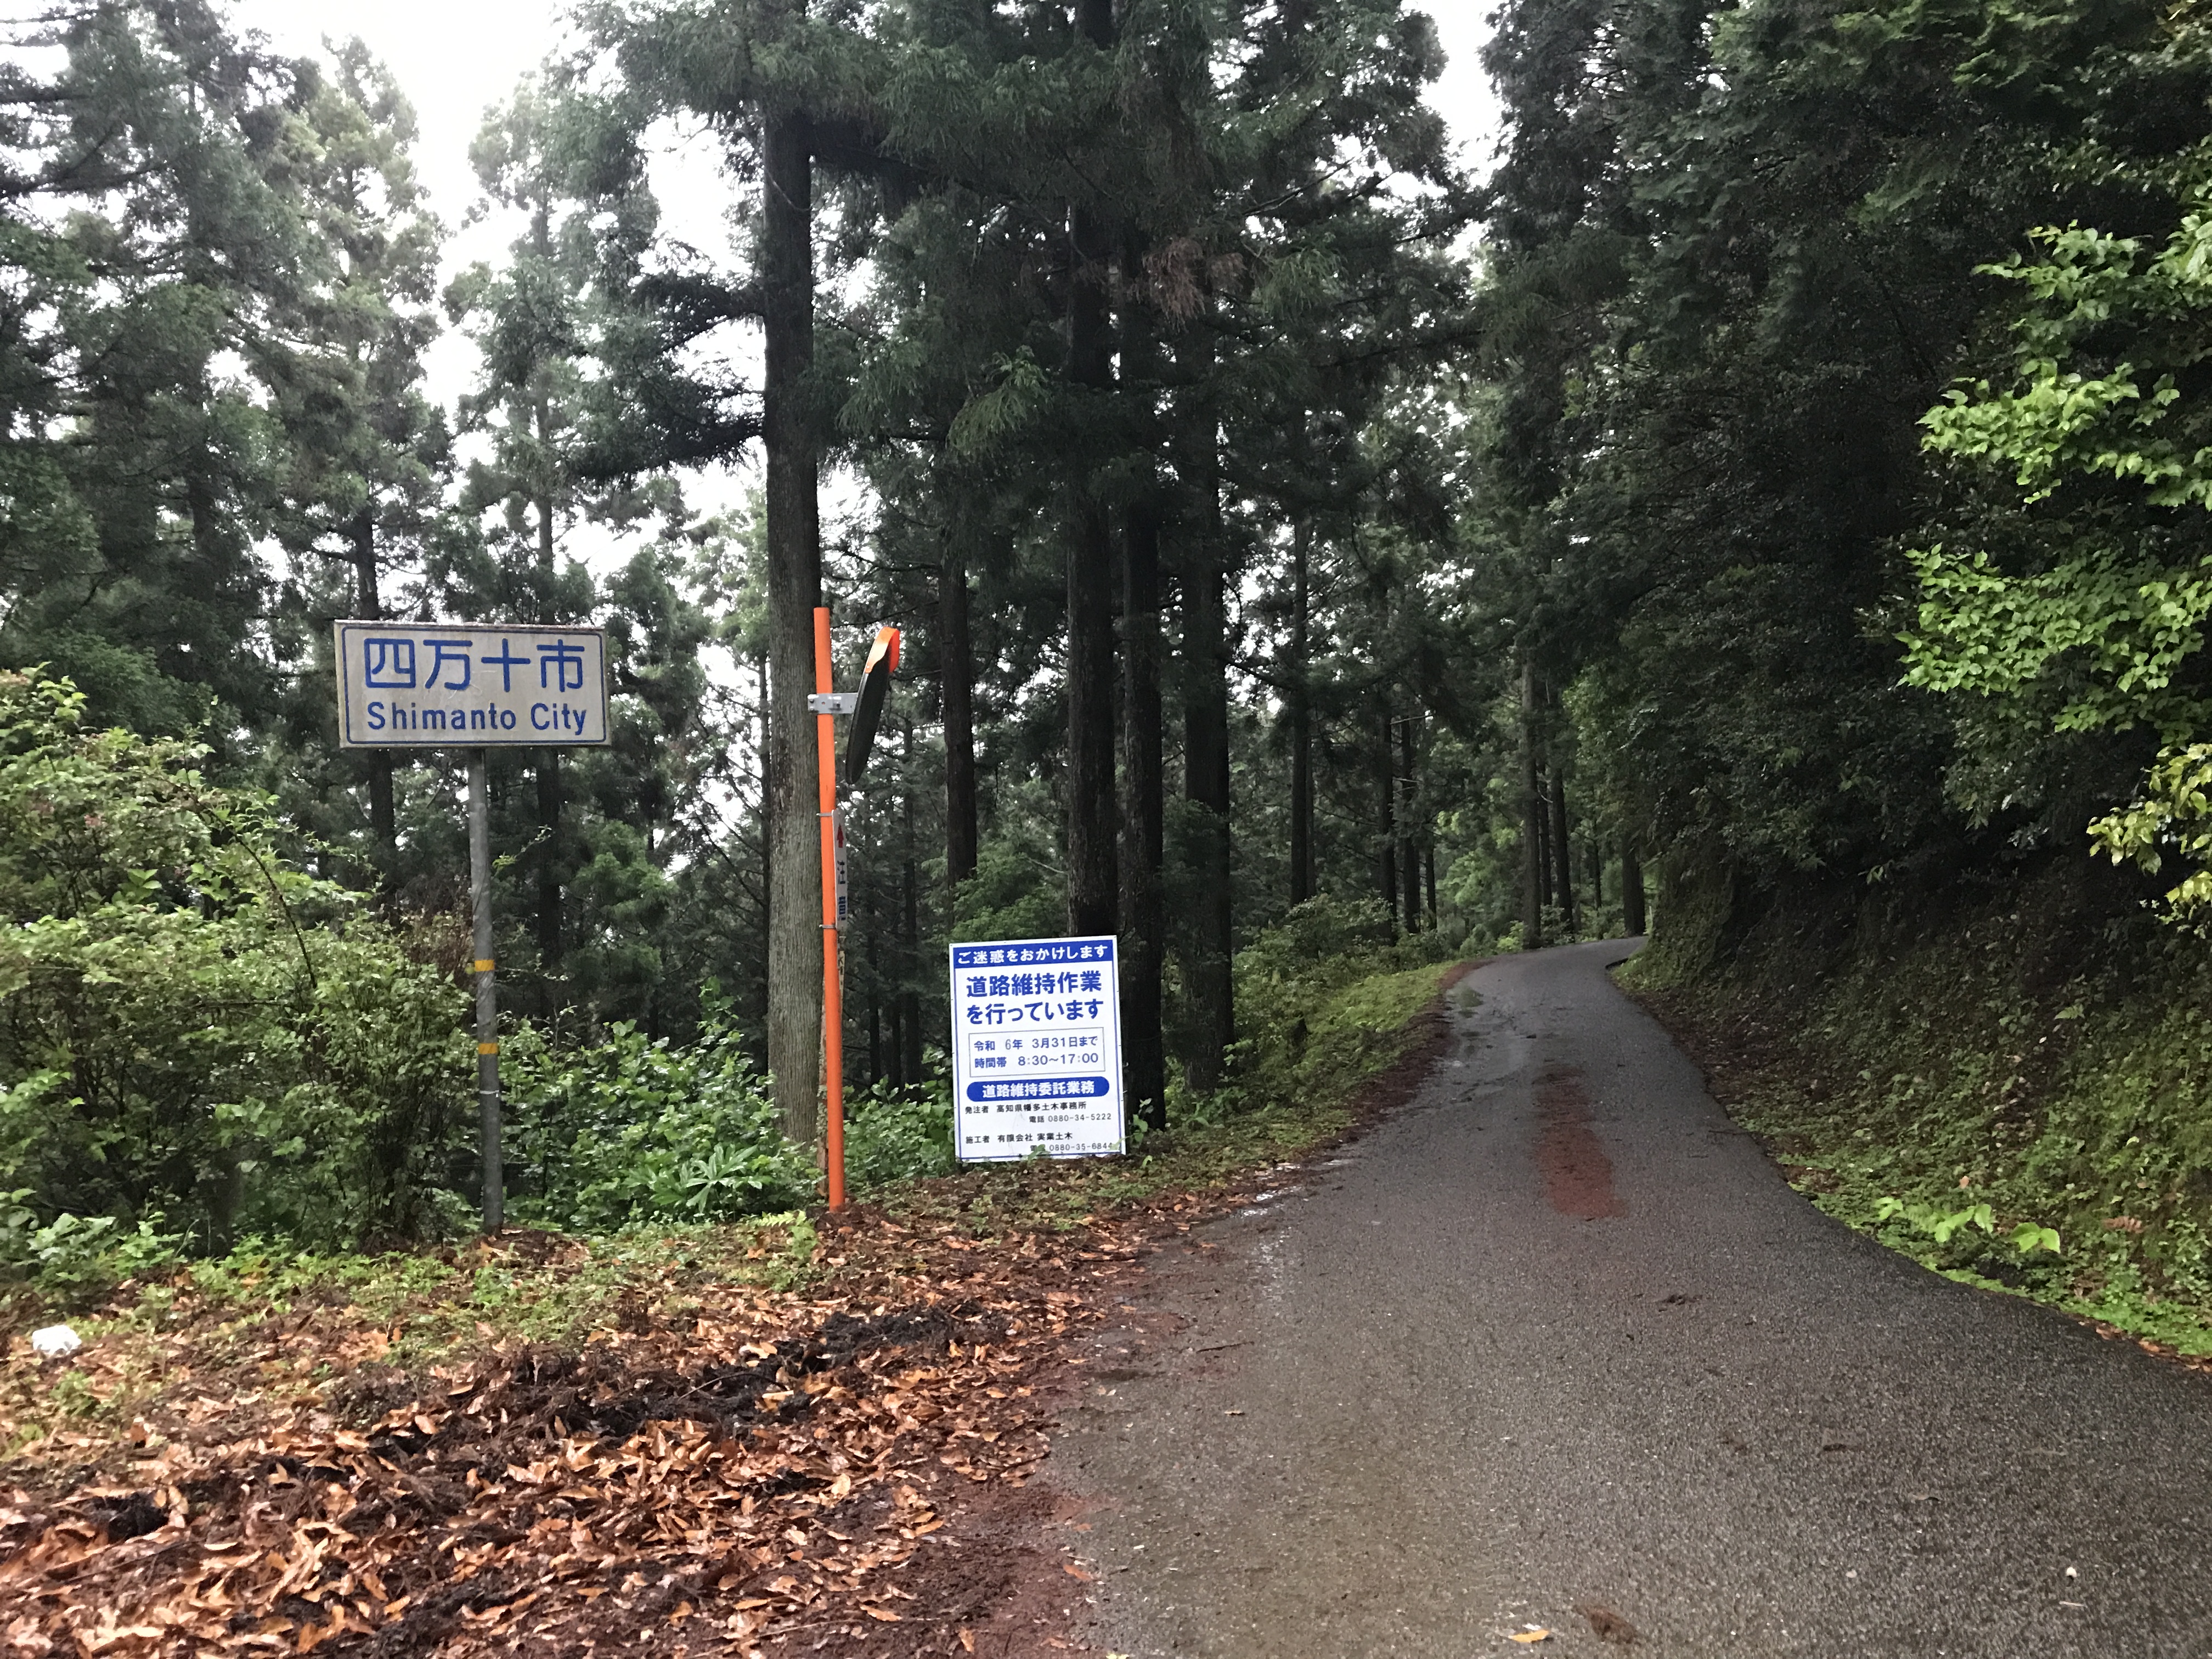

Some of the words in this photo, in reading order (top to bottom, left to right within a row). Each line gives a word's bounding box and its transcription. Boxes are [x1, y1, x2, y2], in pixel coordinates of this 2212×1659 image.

[364, 638, 585, 692] 四万十市
[367, 702, 516, 730] Shimanto
[531, 702, 587, 735] City
[957, 945, 1108, 964] ご迷惑をおかけします
[967, 970, 1102, 997] 道路維持作業
[967, 998, 1104, 1025] を行っています
[974, 1040, 995, 1051] 令和
[1005, 1039, 1023, 1049] 6年
[1032, 1036, 1098, 1048] 3月31日まで
[975, 1057, 1007, 1068] 時間帯
[982, 1080, 1094, 1098] 道路維持委託業務
[965, 1105, 989, 1114] 発注者
[1048, 1113, 1112, 1122] 0880-34-5222
